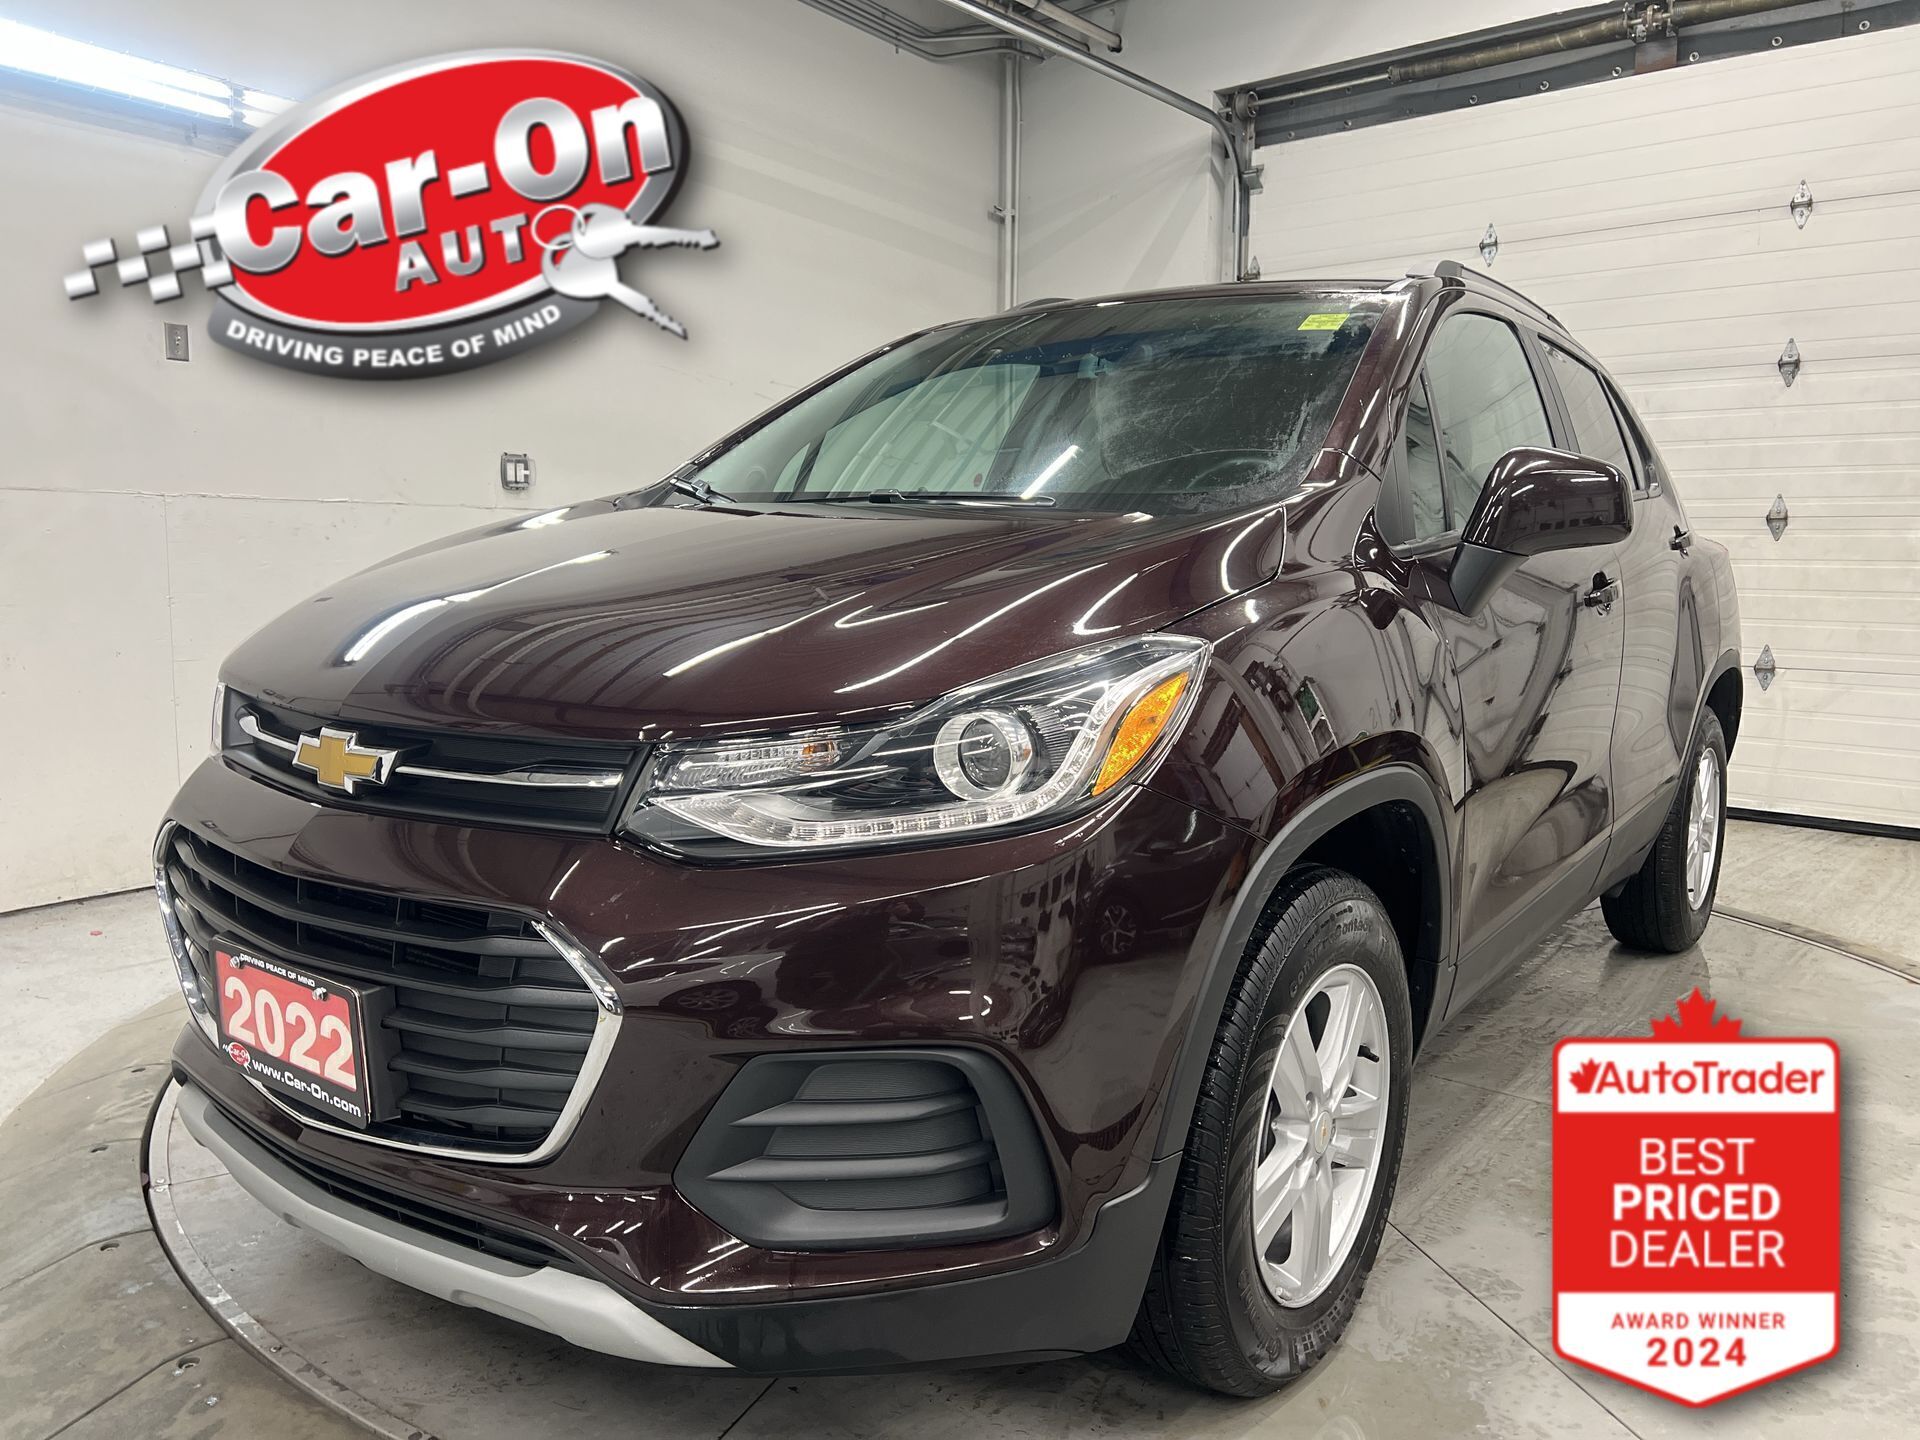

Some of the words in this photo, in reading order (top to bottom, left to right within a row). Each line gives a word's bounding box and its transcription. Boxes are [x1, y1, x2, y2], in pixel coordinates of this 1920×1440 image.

[239, 952, 265, 969] DRIVING
[265, 962, 287, 977] PEACE
[287, 970, 297, 980] OF
[297, 974, 316, 988] MIND
[224, 975, 357, 1091] 2022
[251, 1059, 362, 1118] www.Car-On.com
